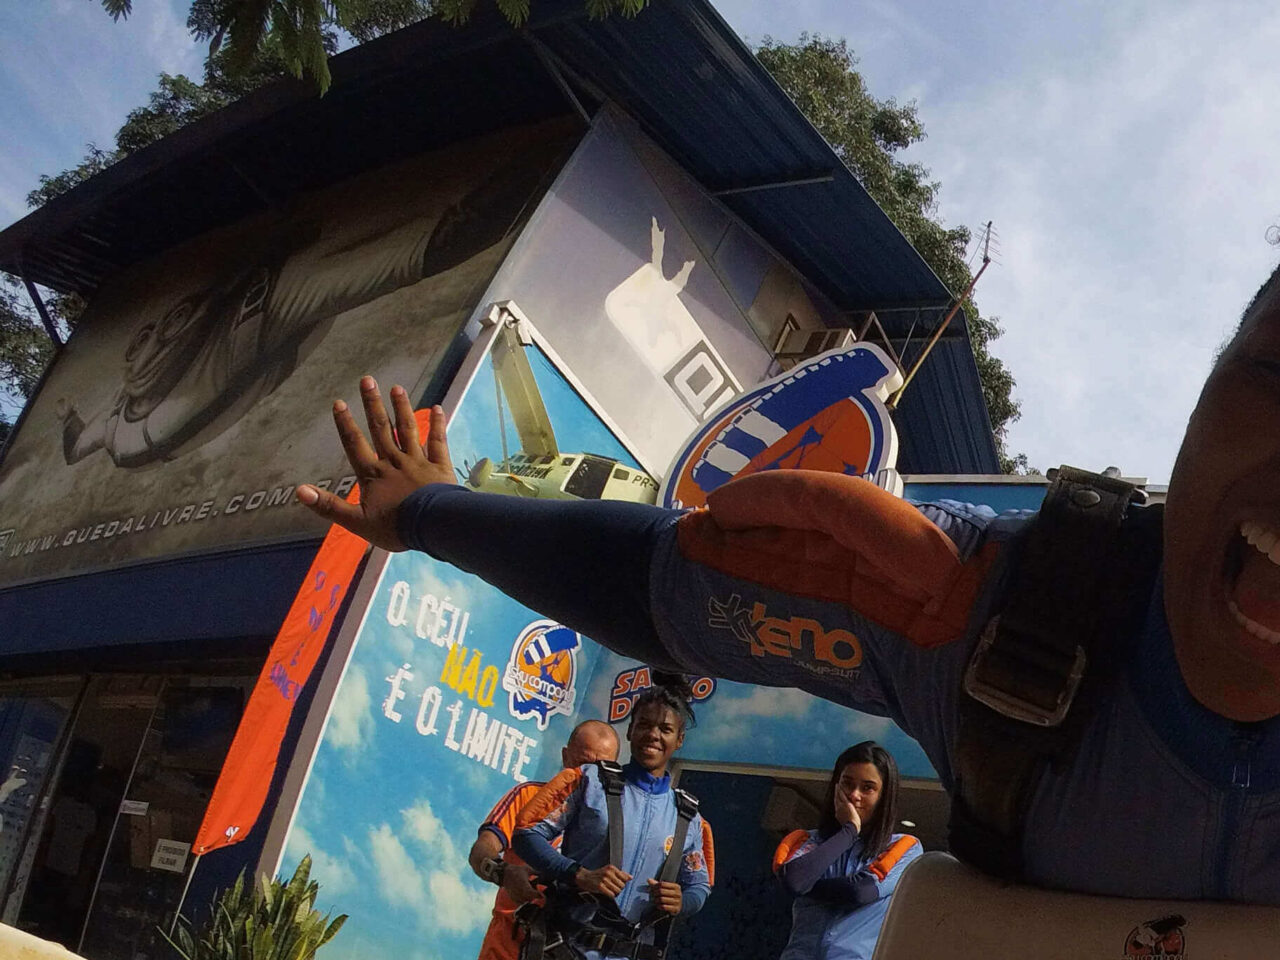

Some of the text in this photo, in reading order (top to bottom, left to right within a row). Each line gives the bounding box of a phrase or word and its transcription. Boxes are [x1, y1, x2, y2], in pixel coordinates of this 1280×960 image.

[386, 581, 411, 627] O
[416, 595, 470, 650] CÉU
[440, 642, 499, 707] NÃO
[613, 667, 714, 700] SAO
[382, 663, 415, 723] É
[416, 686, 443, 736] O
[445, 700, 538, 783] LIMITE
